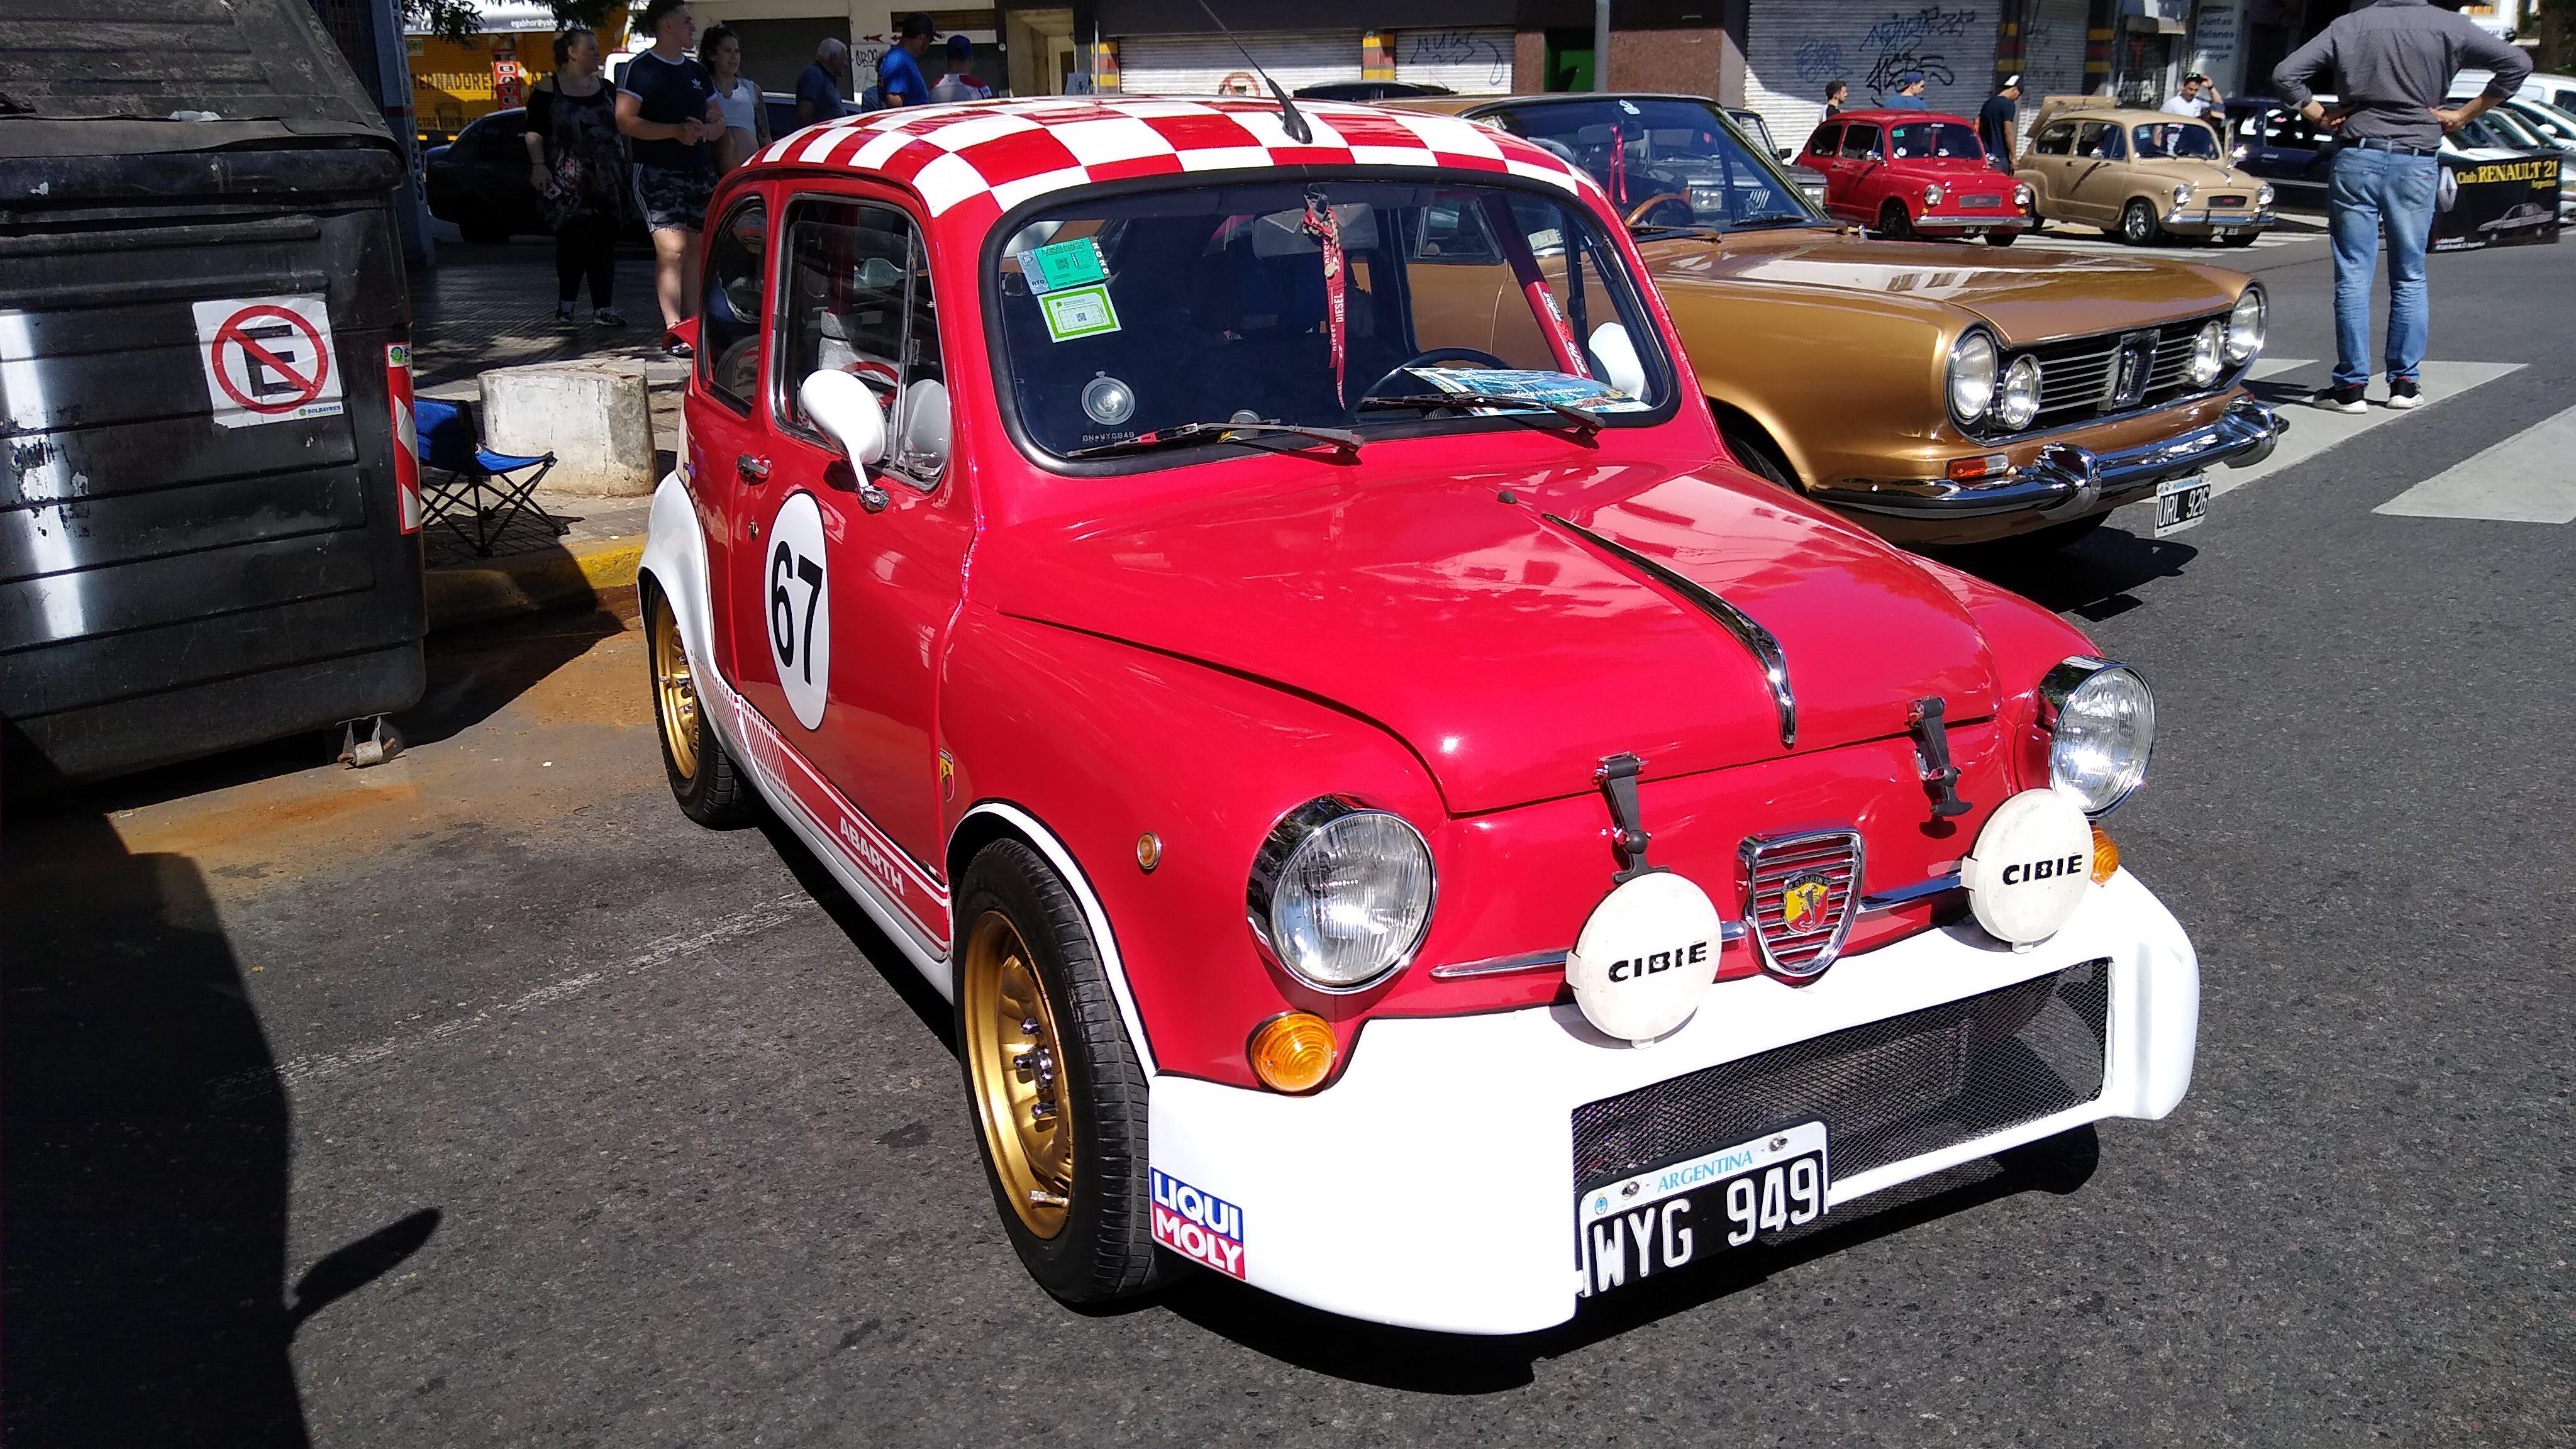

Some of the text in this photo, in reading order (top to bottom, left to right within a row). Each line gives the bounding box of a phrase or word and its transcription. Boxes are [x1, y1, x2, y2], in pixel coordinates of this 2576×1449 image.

[2456, 160, 2557, 184] Club RENAULT 21
[1333, 292, 1345, 323] DIESEL
[307, 405, 341, 414] SOLBAYRES
[2158, 486, 2209, 526] URL 926
[771, 540, 823, 687] 67
[839, 816, 905, 896] ABARTH
[2002, 853, 2083, 886] CIBIE
[1608, 941, 1707, 982] CIBIE
[1657, 1150, 1753, 1193] ARGENTINA
[1153, 1170, 1240, 1241] LIQUI
[1594, 1157, 1819, 1293] WYG 949
[1155, 1207, 1243, 1274] MOLY
